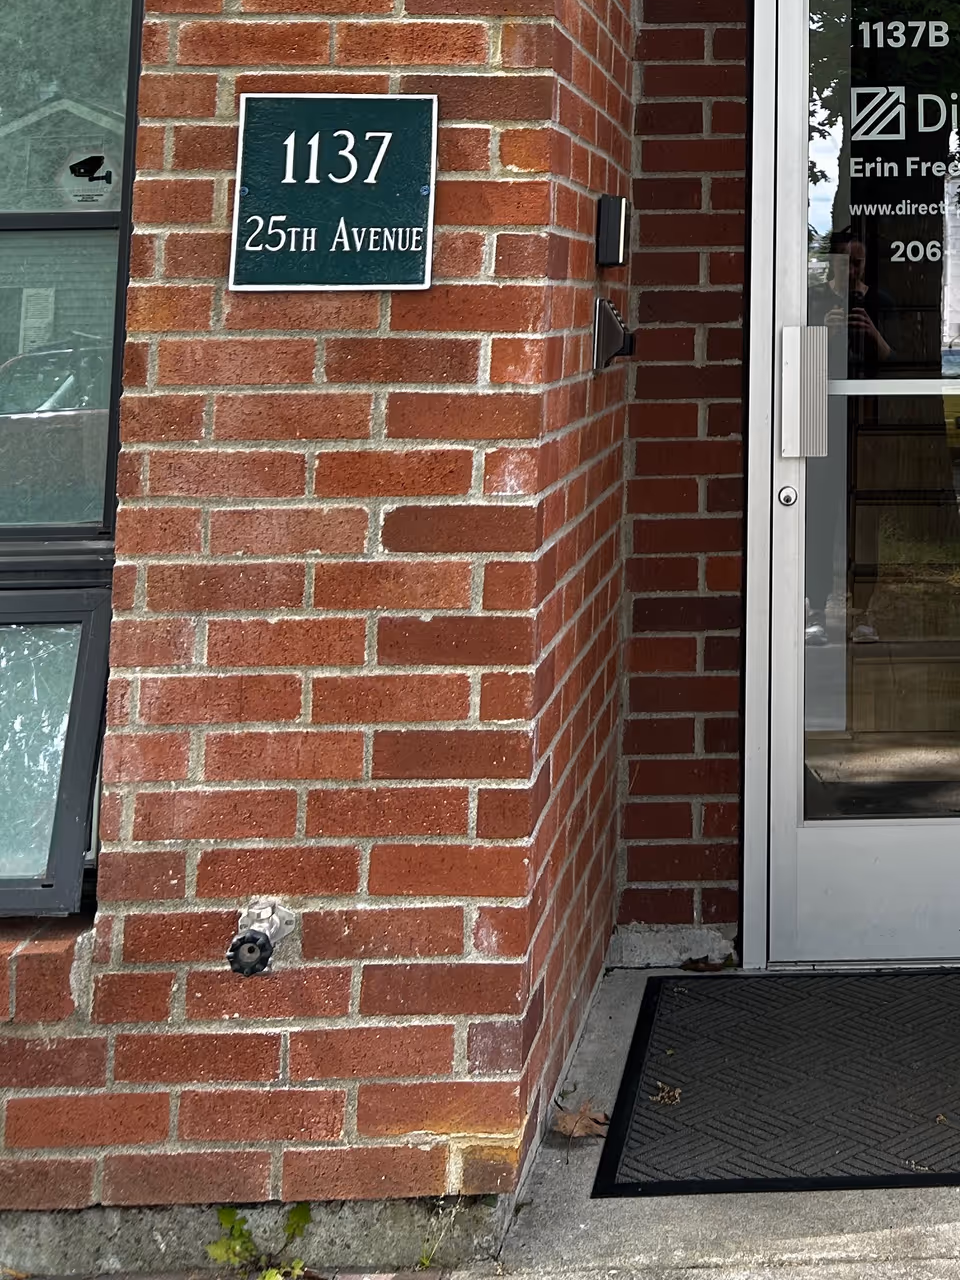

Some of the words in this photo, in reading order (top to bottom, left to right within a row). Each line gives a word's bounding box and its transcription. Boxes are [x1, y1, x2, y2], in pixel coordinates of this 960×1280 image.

[858, 20, 950, 48] 1137B
[281, 129, 393, 184] 1137
[849, 156, 899, 178] Erin
[244, 215, 318, 252] 25TH
[329, 216, 424, 252] AVENUE
